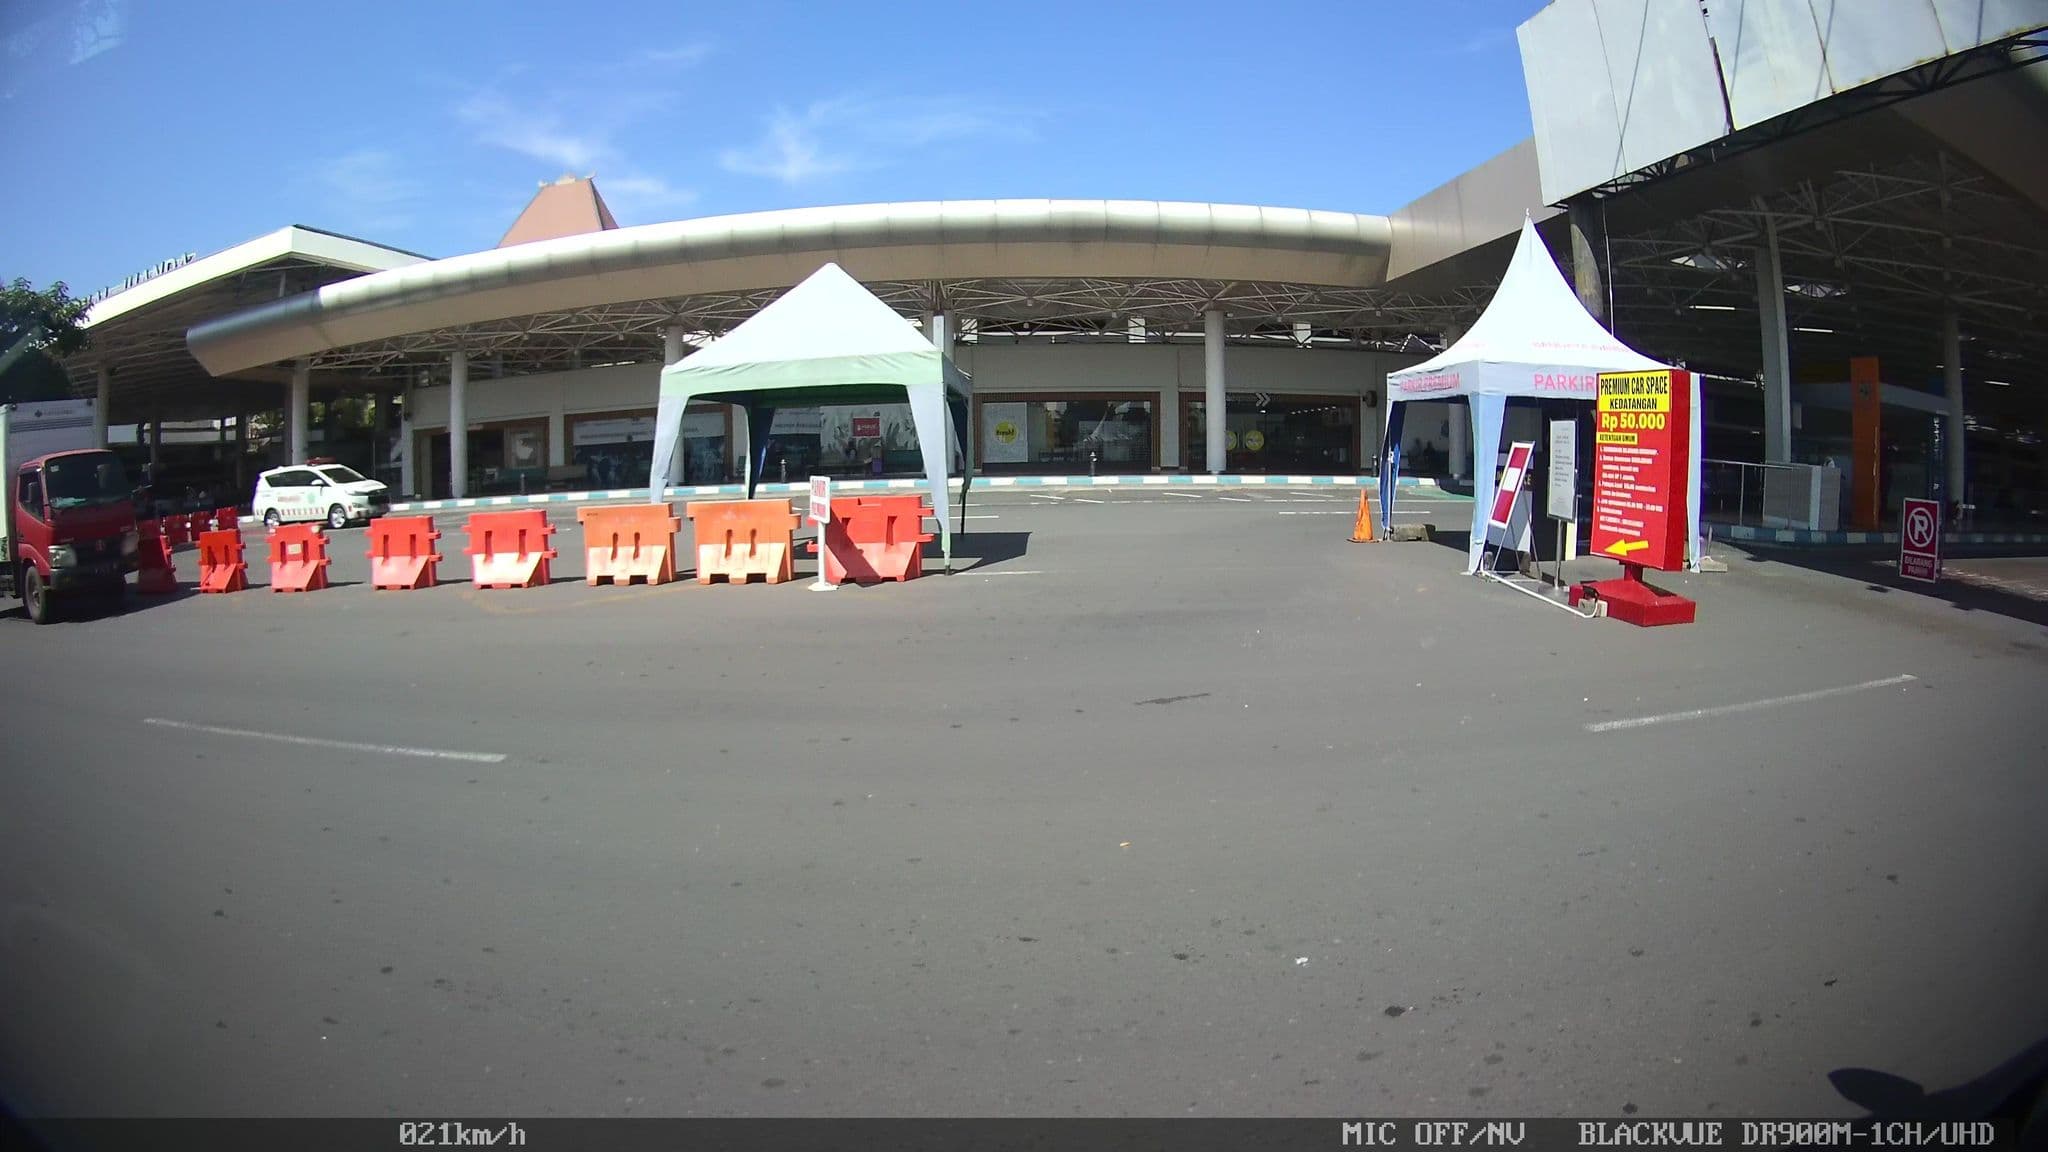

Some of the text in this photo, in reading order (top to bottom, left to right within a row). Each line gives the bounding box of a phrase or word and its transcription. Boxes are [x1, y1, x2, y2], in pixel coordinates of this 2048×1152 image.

[1533, 373, 1595, 392] PARKIR
[1600, 376, 1668, 395] PREMIUM CAR SPACE
[1609, 398, 1657, 410] KEDATANGAN
[1601, 413, 1666, 432] Rp 50.000
